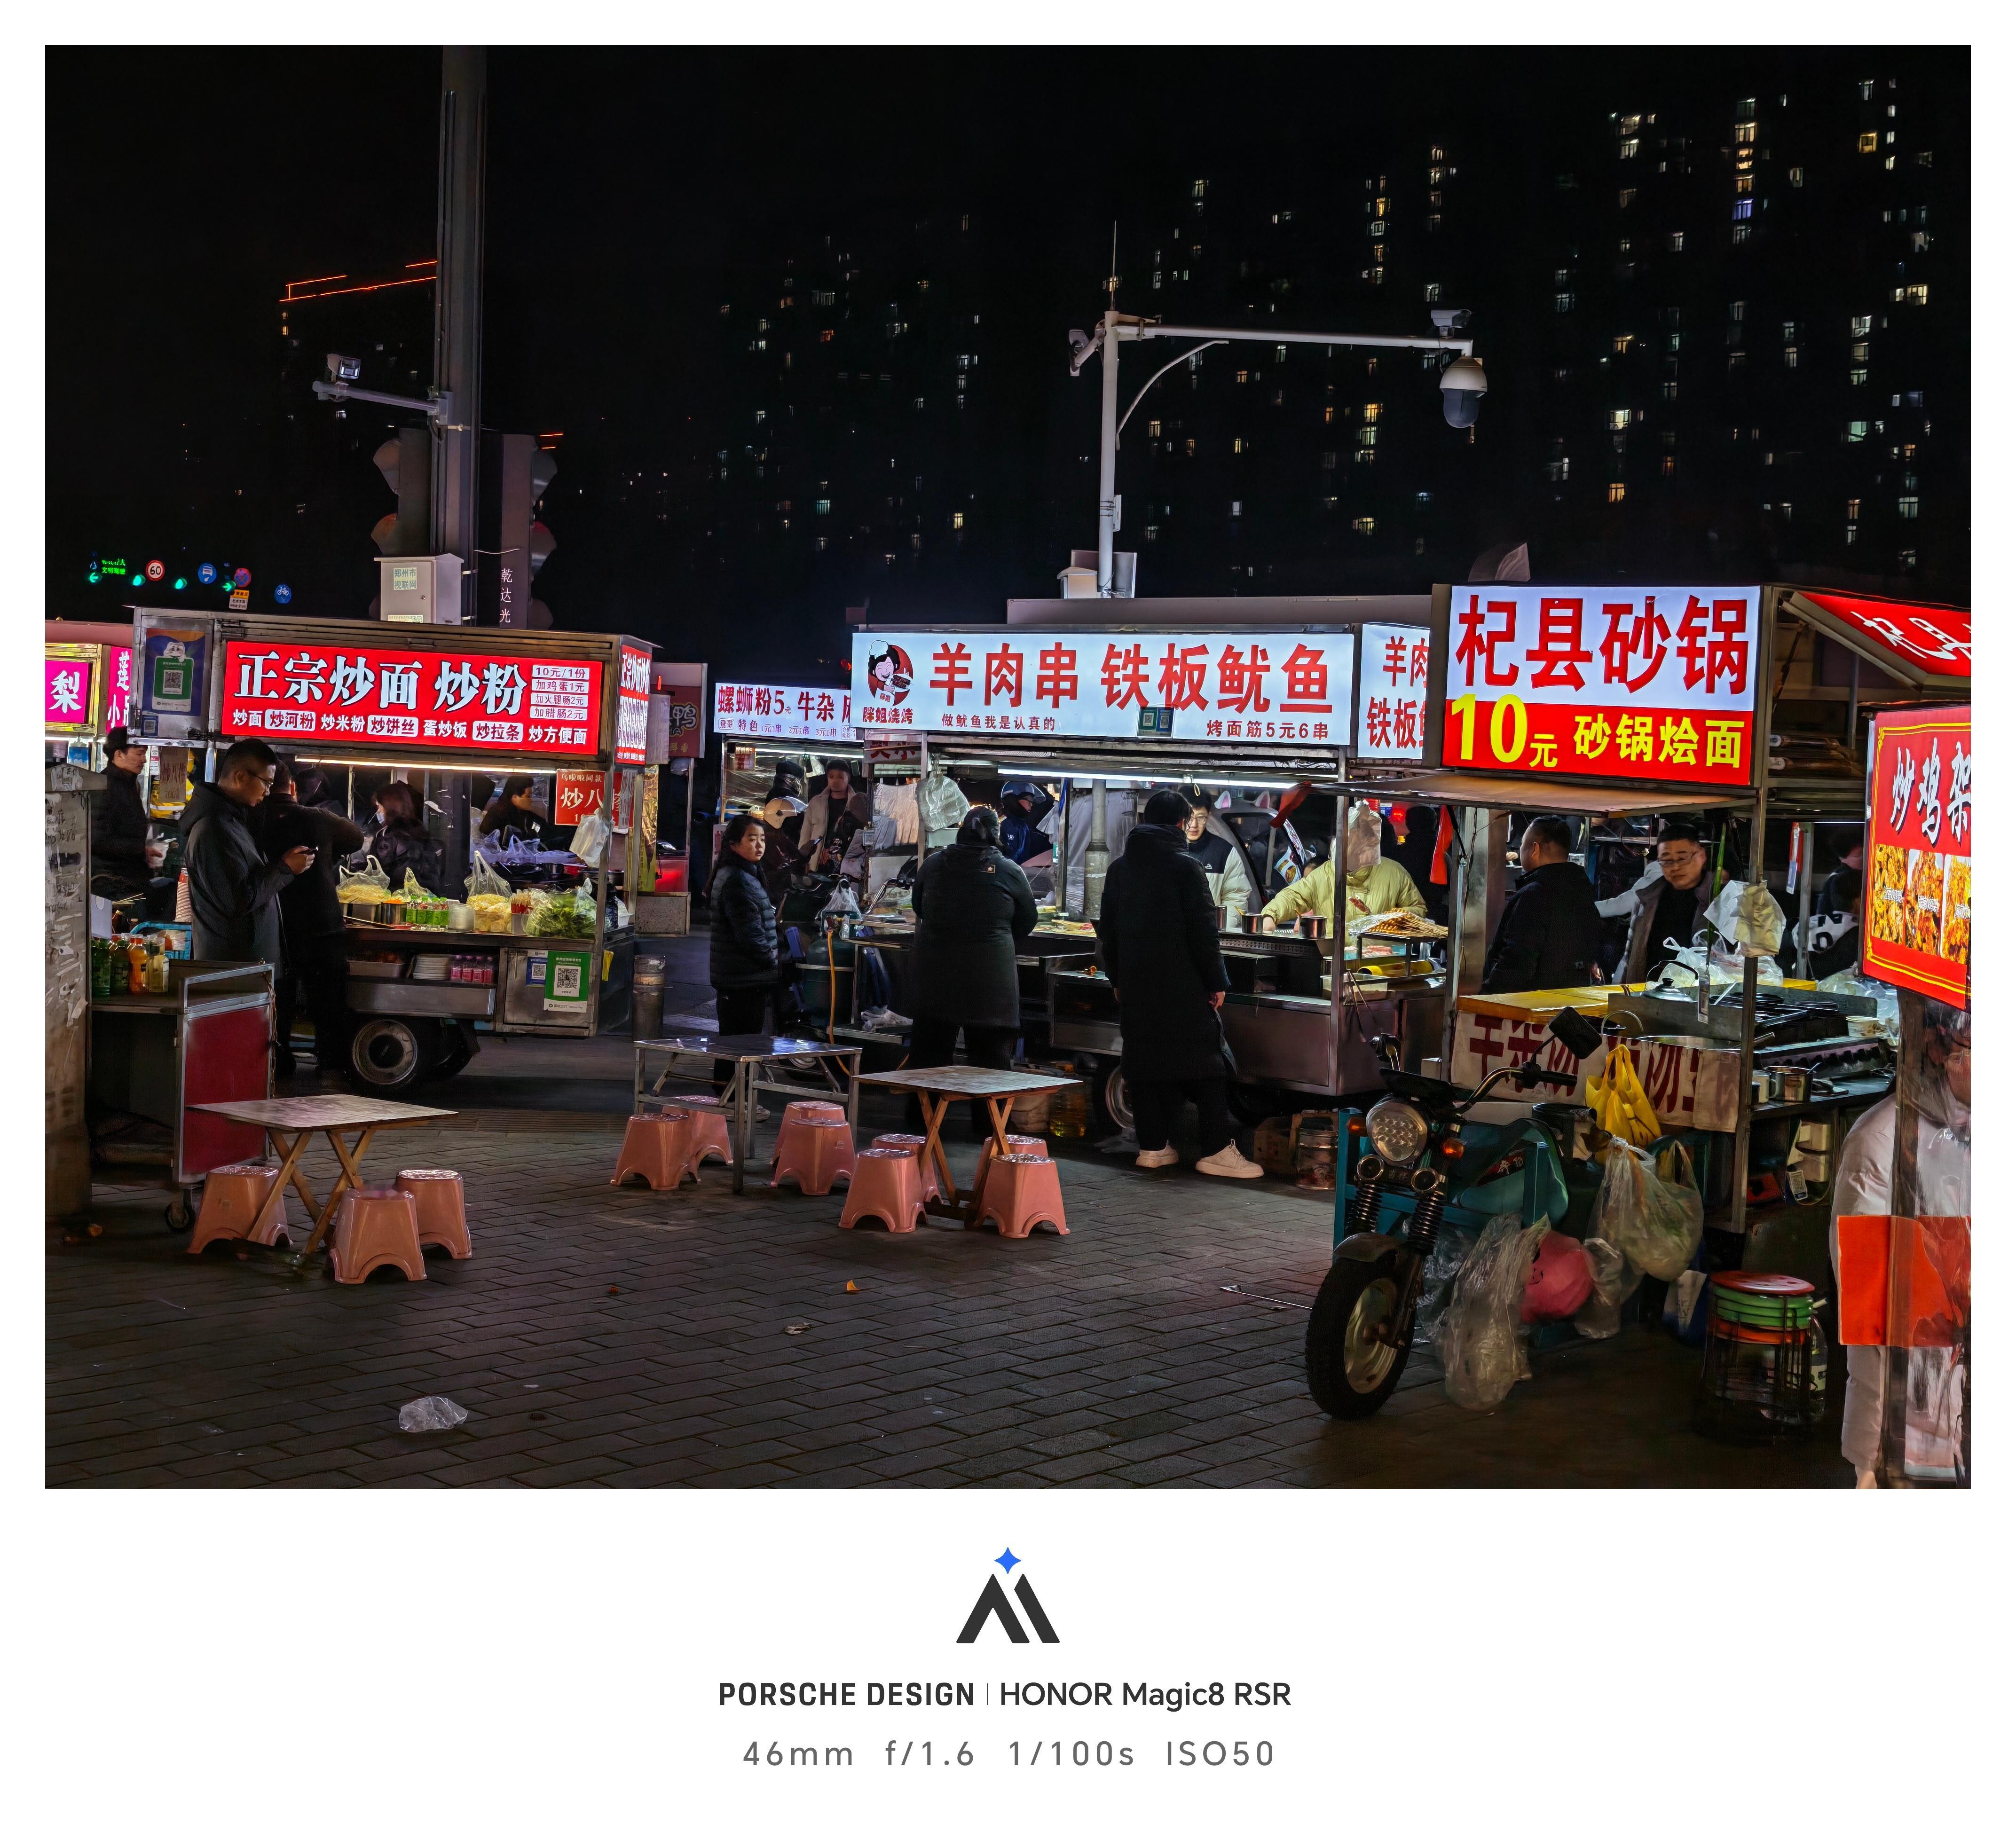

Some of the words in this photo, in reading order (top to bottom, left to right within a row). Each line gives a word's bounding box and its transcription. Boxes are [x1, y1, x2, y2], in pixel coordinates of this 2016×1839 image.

[150, 566, 161, 575] 60
[394, 568, 417, 578] 郑州市
[394, 580, 417, 589] 视联网
[499, 568, 512, 623] 乾达光
[1456, 595, 1748, 694] 杞县砂锅
[536, 667, 586, 678] 10元/1份
[1383, 636, 1427, 687] 羊肉
[49, 670, 82, 714] 梨
[234, 651, 423, 709] 正宗炒面
[433, 661, 527, 715] 炒粉
[536, 680, 585, 692] 加鸡蛋1元
[929, 642, 1078, 709] 羊肉串
[1101, 643, 1332, 714] 铁板鱿鱼
[534, 707, 583, 719] 加腊肠2元
[535, 694, 584, 706] 加火腿肠2元
[717, 684, 791, 715] 螺蛳粉5元
[798, 691, 834, 723] 牛杂
[863, 707, 913, 724] 胖姐烧烤
[233, 709, 263, 727] 炒面
[269, 711, 314, 730] 炒河粉
[321, 714, 365, 732] 炒米粉
[370, 717, 415, 735] 炒饼丝
[423, 719, 468, 738] 蛋炒饭
[476, 723, 520, 741] 炒拉条
[528, 724, 588, 745] 炒方便面
[669, 705, 696, 727] 鸭
[738, 719, 757, 732] 特色
[942, 713, 1055, 731] 做鱿鱼我是认真的
[1206, 719, 1329, 740] 烤面筋5元6串
[1367, 696, 1425, 749] 铁板
[1451, 693, 1558, 768] 10元
[1573, 713, 1745, 769] 砂锅烩面
[1890, 738, 1971, 844] 炒鸡架
